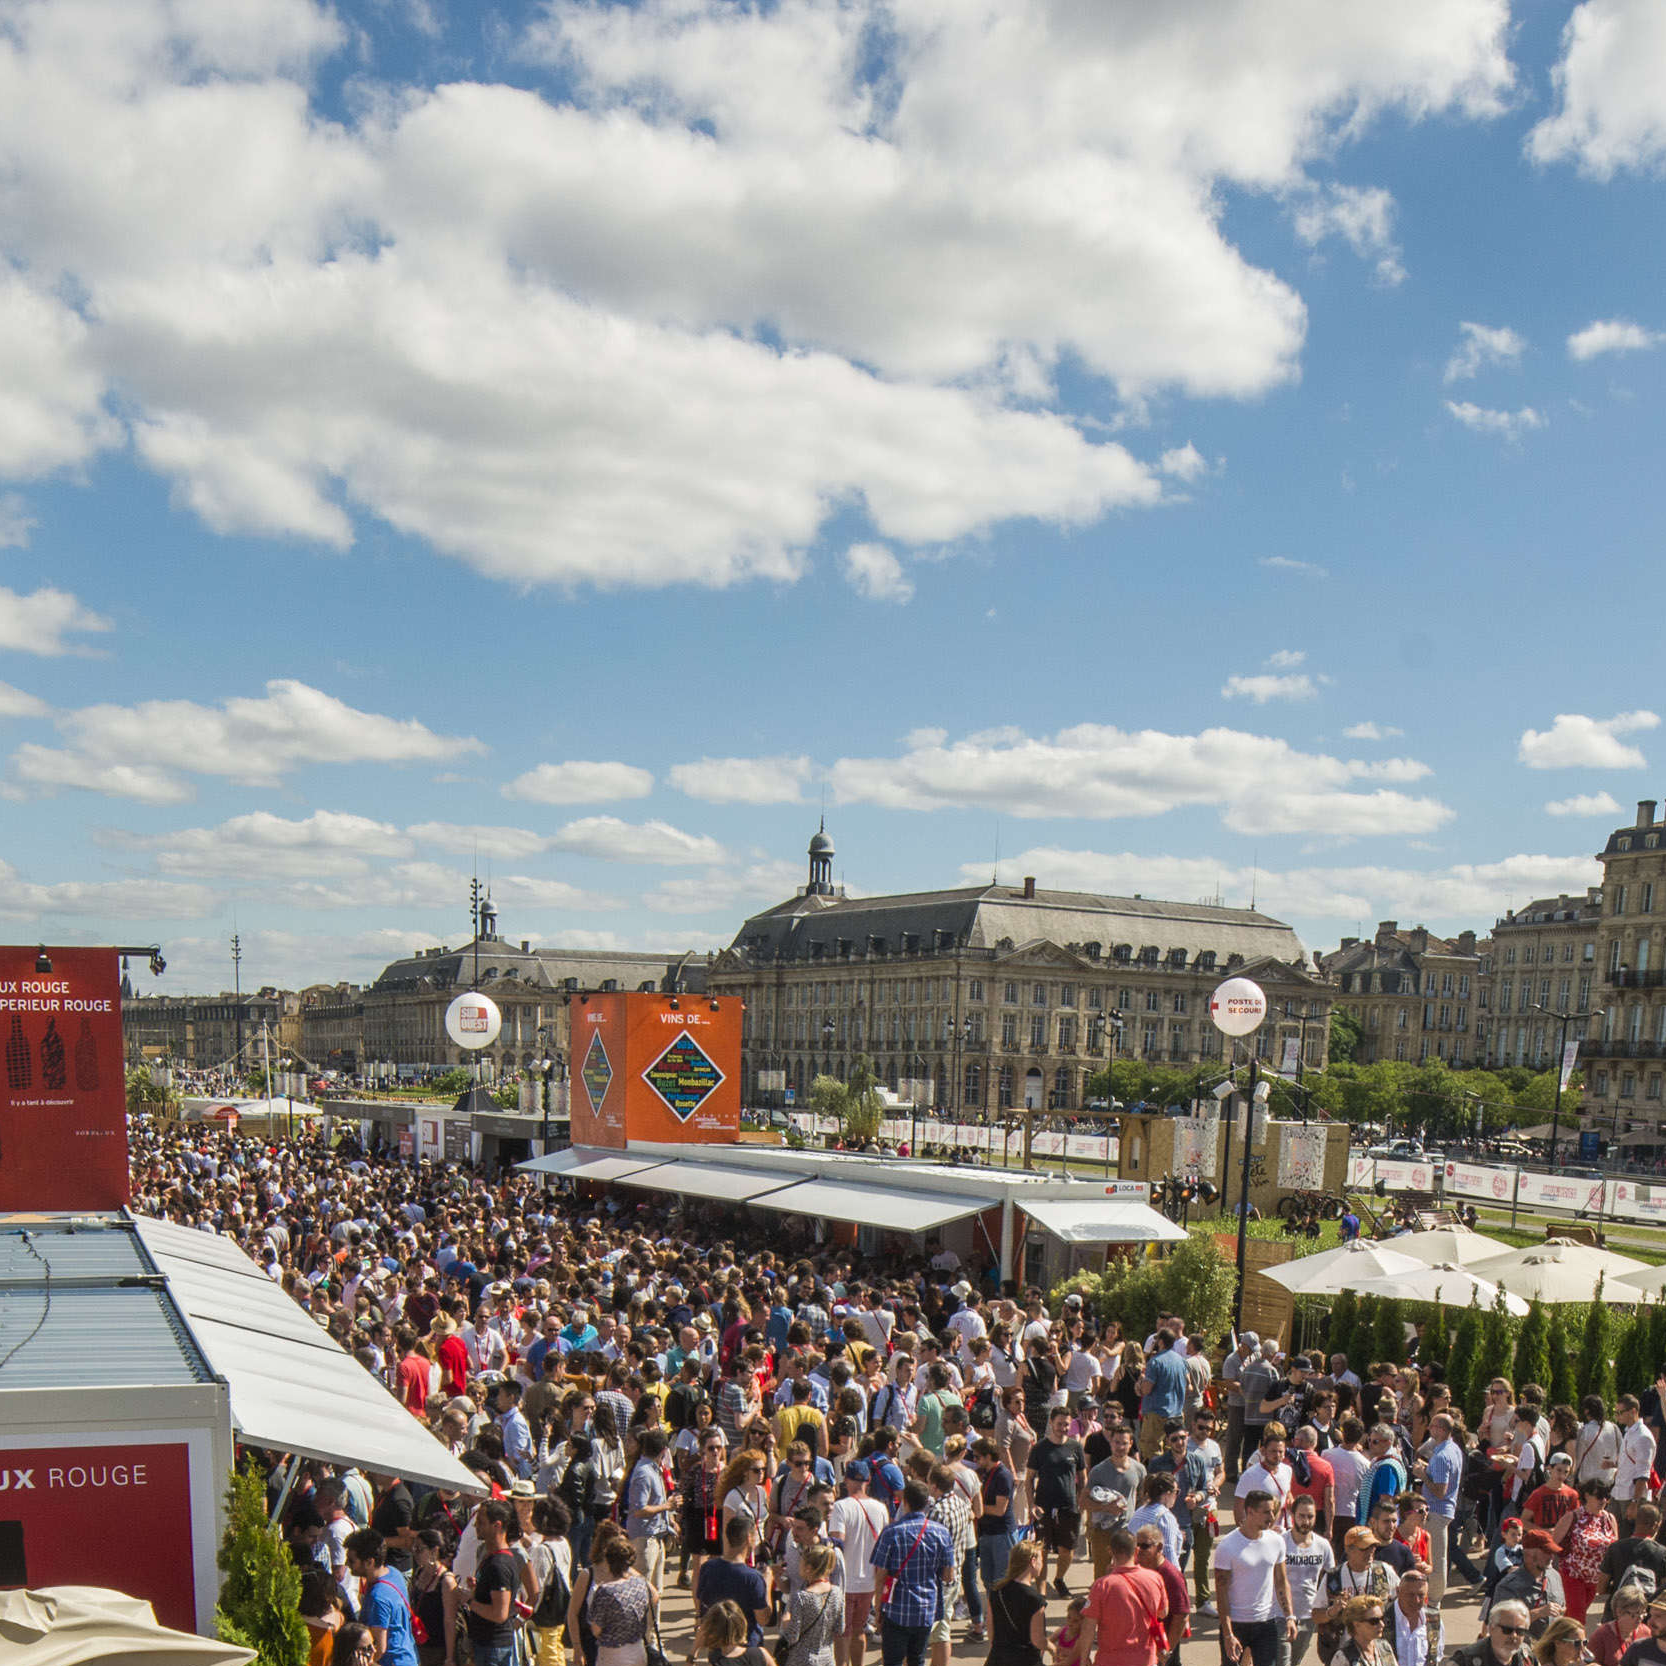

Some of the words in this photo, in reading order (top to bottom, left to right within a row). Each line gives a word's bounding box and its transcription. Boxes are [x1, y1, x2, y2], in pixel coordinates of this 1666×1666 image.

[21, 981, 69, 994] ROUGE
[63, 1001, 112, 1012] ROUGE
[460, 1019, 488, 1030] OUEST
[660, 1014, 684, 1024] VINS
[48, 1464, 148, 1488] ROUGE
